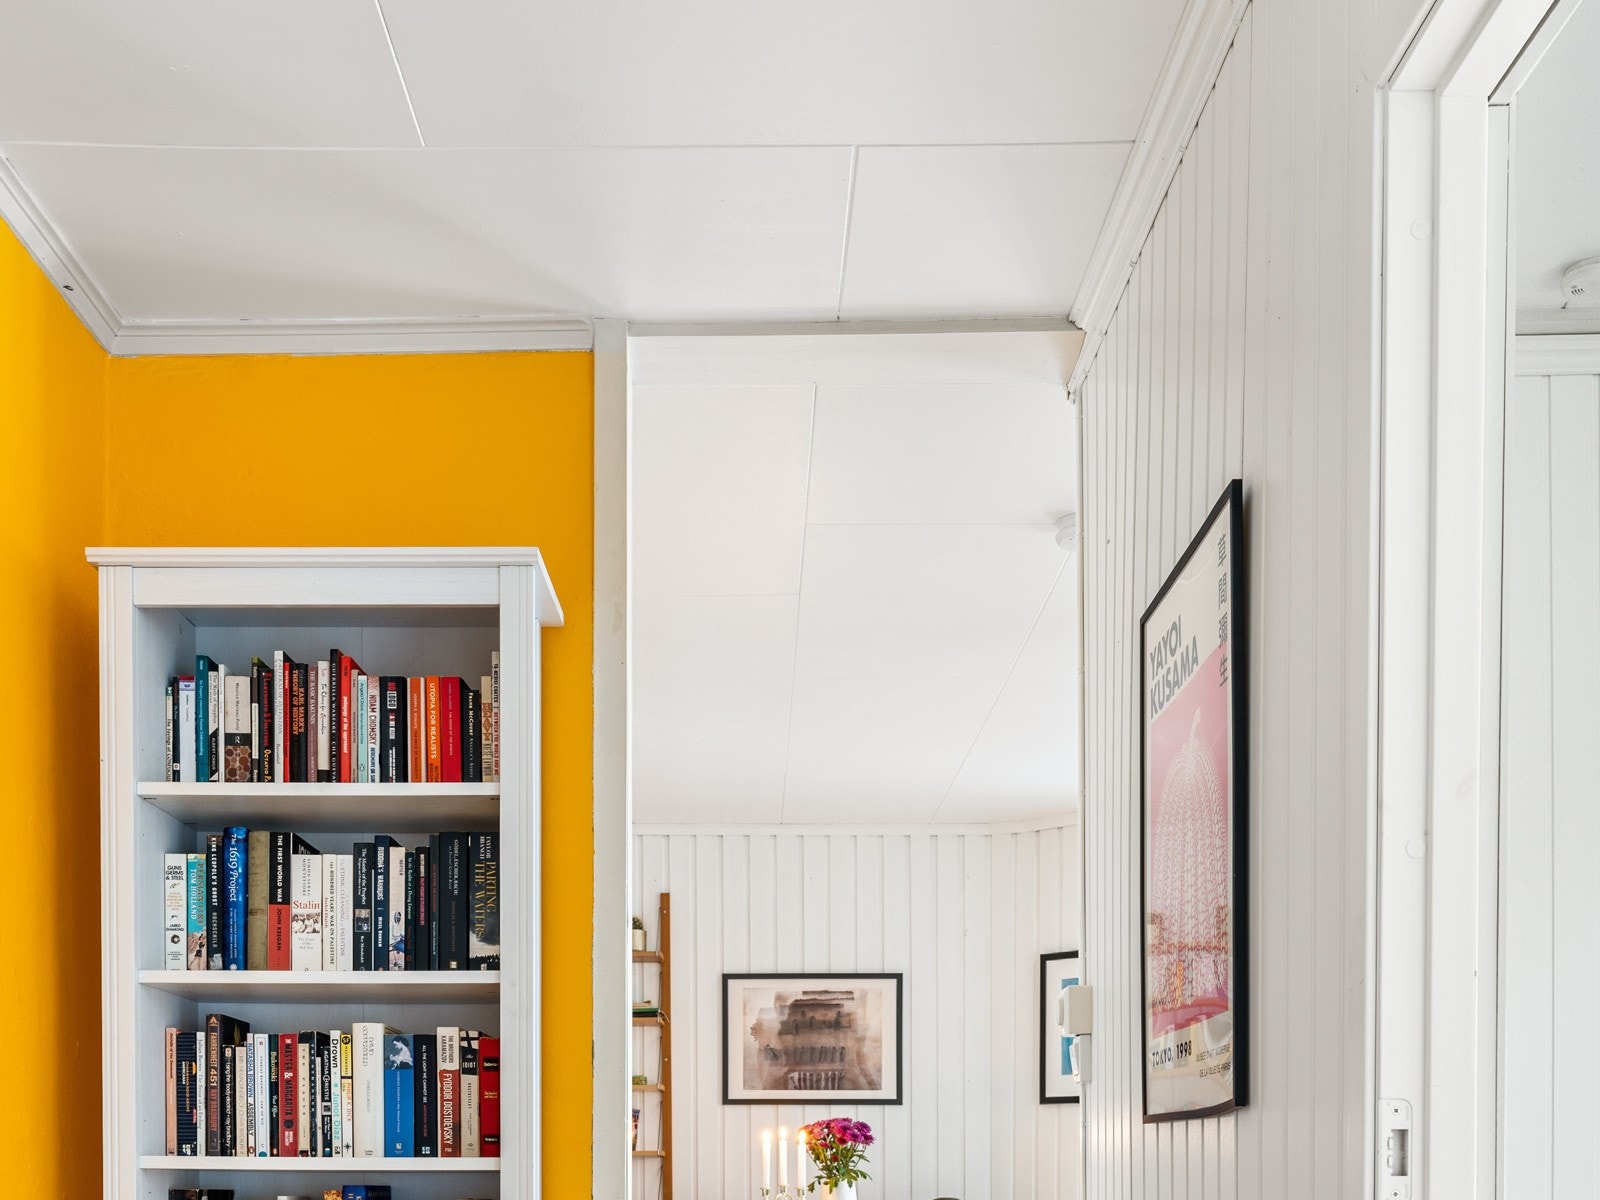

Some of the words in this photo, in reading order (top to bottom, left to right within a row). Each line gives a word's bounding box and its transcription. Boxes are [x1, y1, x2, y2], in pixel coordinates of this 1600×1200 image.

[1150, 614, 1182, 680] YAYOI
[388, 682, 396, 691] NO
[1150, 635, 1199, 719] KUSAMA
[293, 697, 299, 705] OF
[388, 692, 396, 708] LOGO
[227, 847, 239, 869] 1619
[228, 870, 239, 901] Project
[475, 862, 485, 887] THE
[486, 861, 496, 913] PARTING
[293, 900, 320, 909] Stalin
[474, 890, 486, 939] WATERS
[329, 927, 335, 936] ON
[284, 1043, 292, 1071] MASTER
[1152, 1047, 1174, 1067] TOKYO,
[1176, 1040, 1192, 1059] 1998
[284, 1080, 292, 1116] MARGARITA
[443, 1073, 452, 1100] FYODOR
[443, 1101, 453, 1145] DOSTOEVSKY
